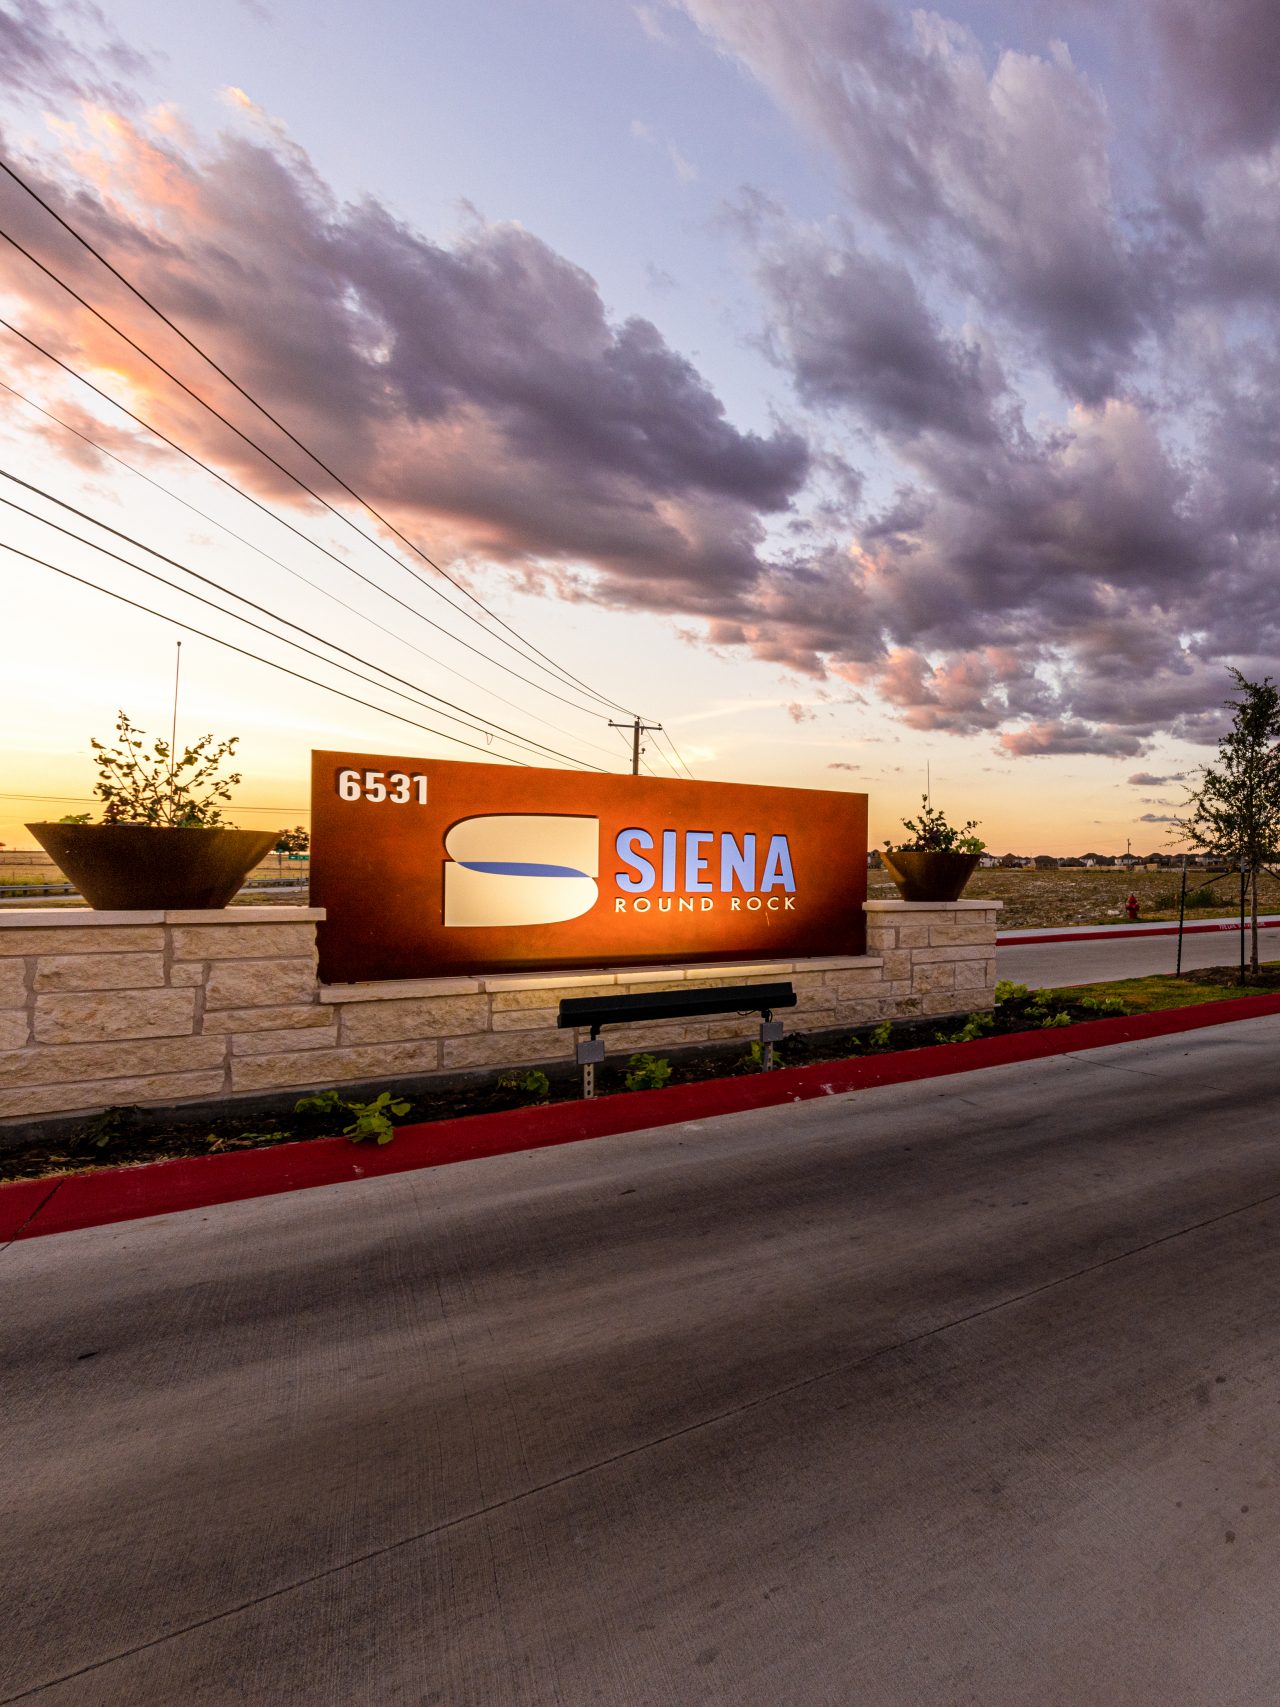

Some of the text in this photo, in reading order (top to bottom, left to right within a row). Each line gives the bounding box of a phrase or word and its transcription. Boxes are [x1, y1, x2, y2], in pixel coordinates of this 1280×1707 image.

[339, 770, 428, 805] 6531
[614, 827, 797, 893] SIENA
[614, 896, 796, 913] ROUND ROCK
